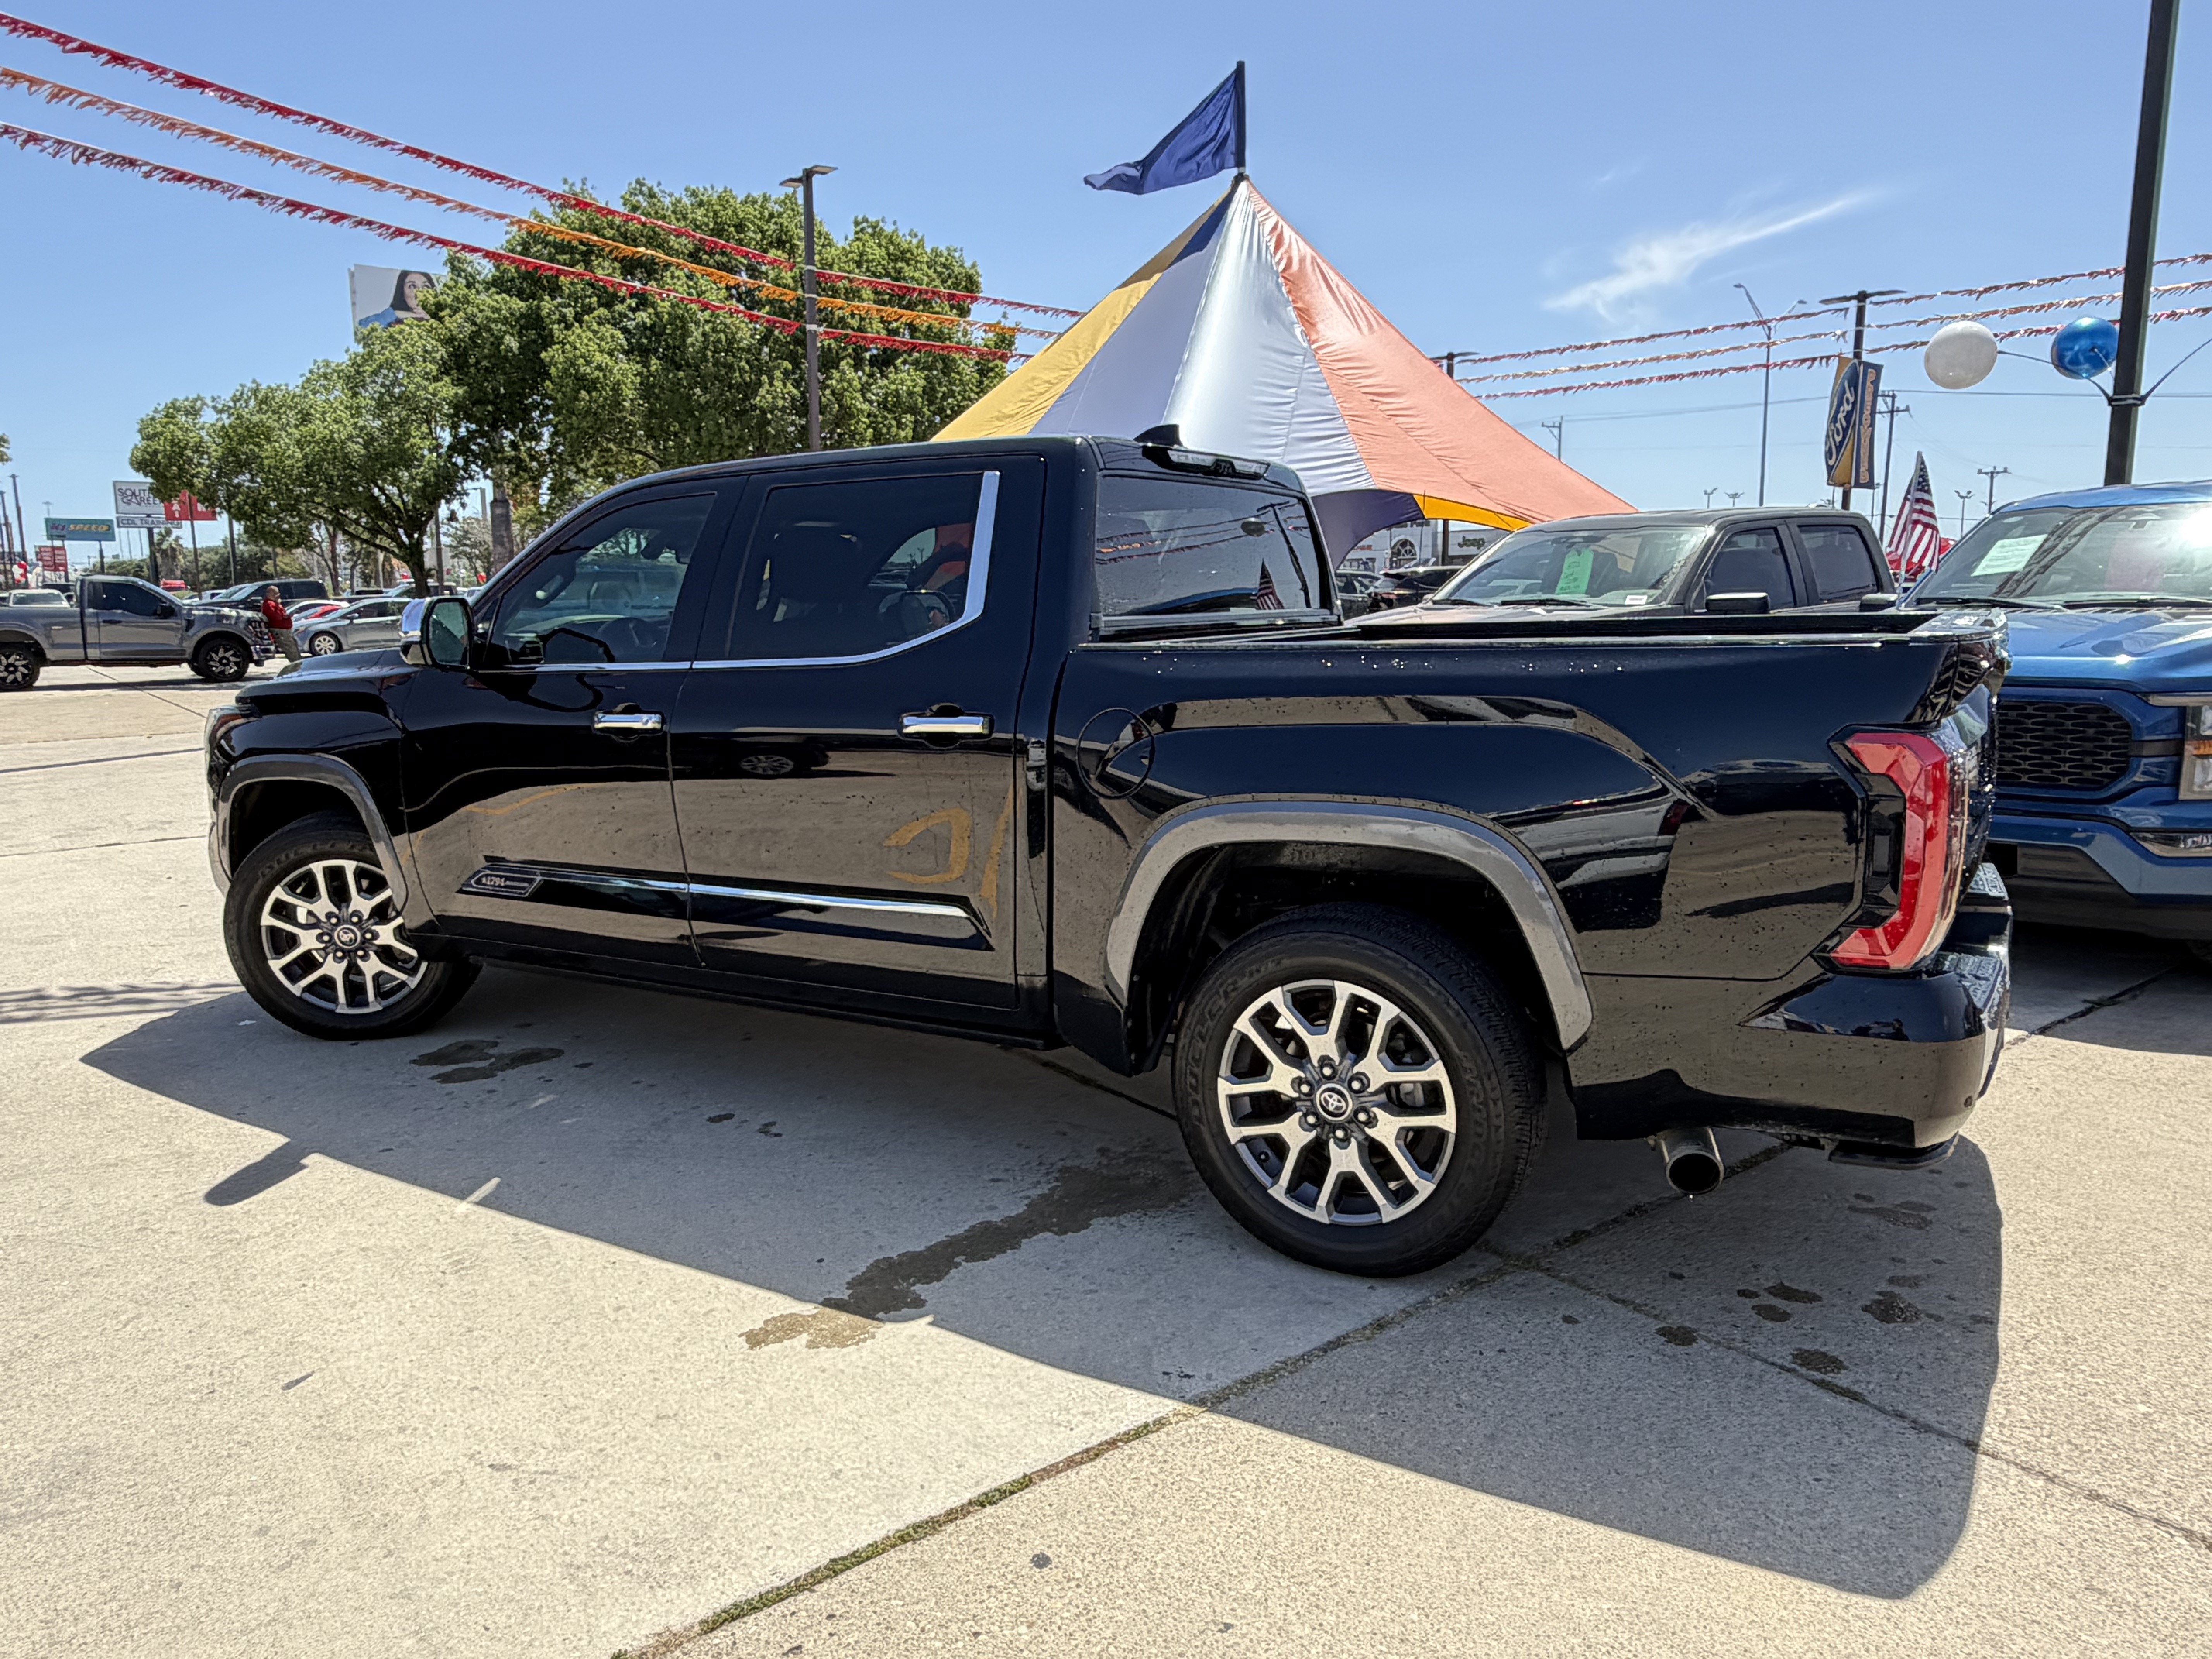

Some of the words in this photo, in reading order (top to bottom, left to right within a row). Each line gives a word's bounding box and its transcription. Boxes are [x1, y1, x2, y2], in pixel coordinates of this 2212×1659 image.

[1825, 380, 1855, 466] Ford
[118, 488, 151, 496] SOUT
[121, 495, 162, 506] CAREE
[1458, 536, 1486, 550] Jeep
